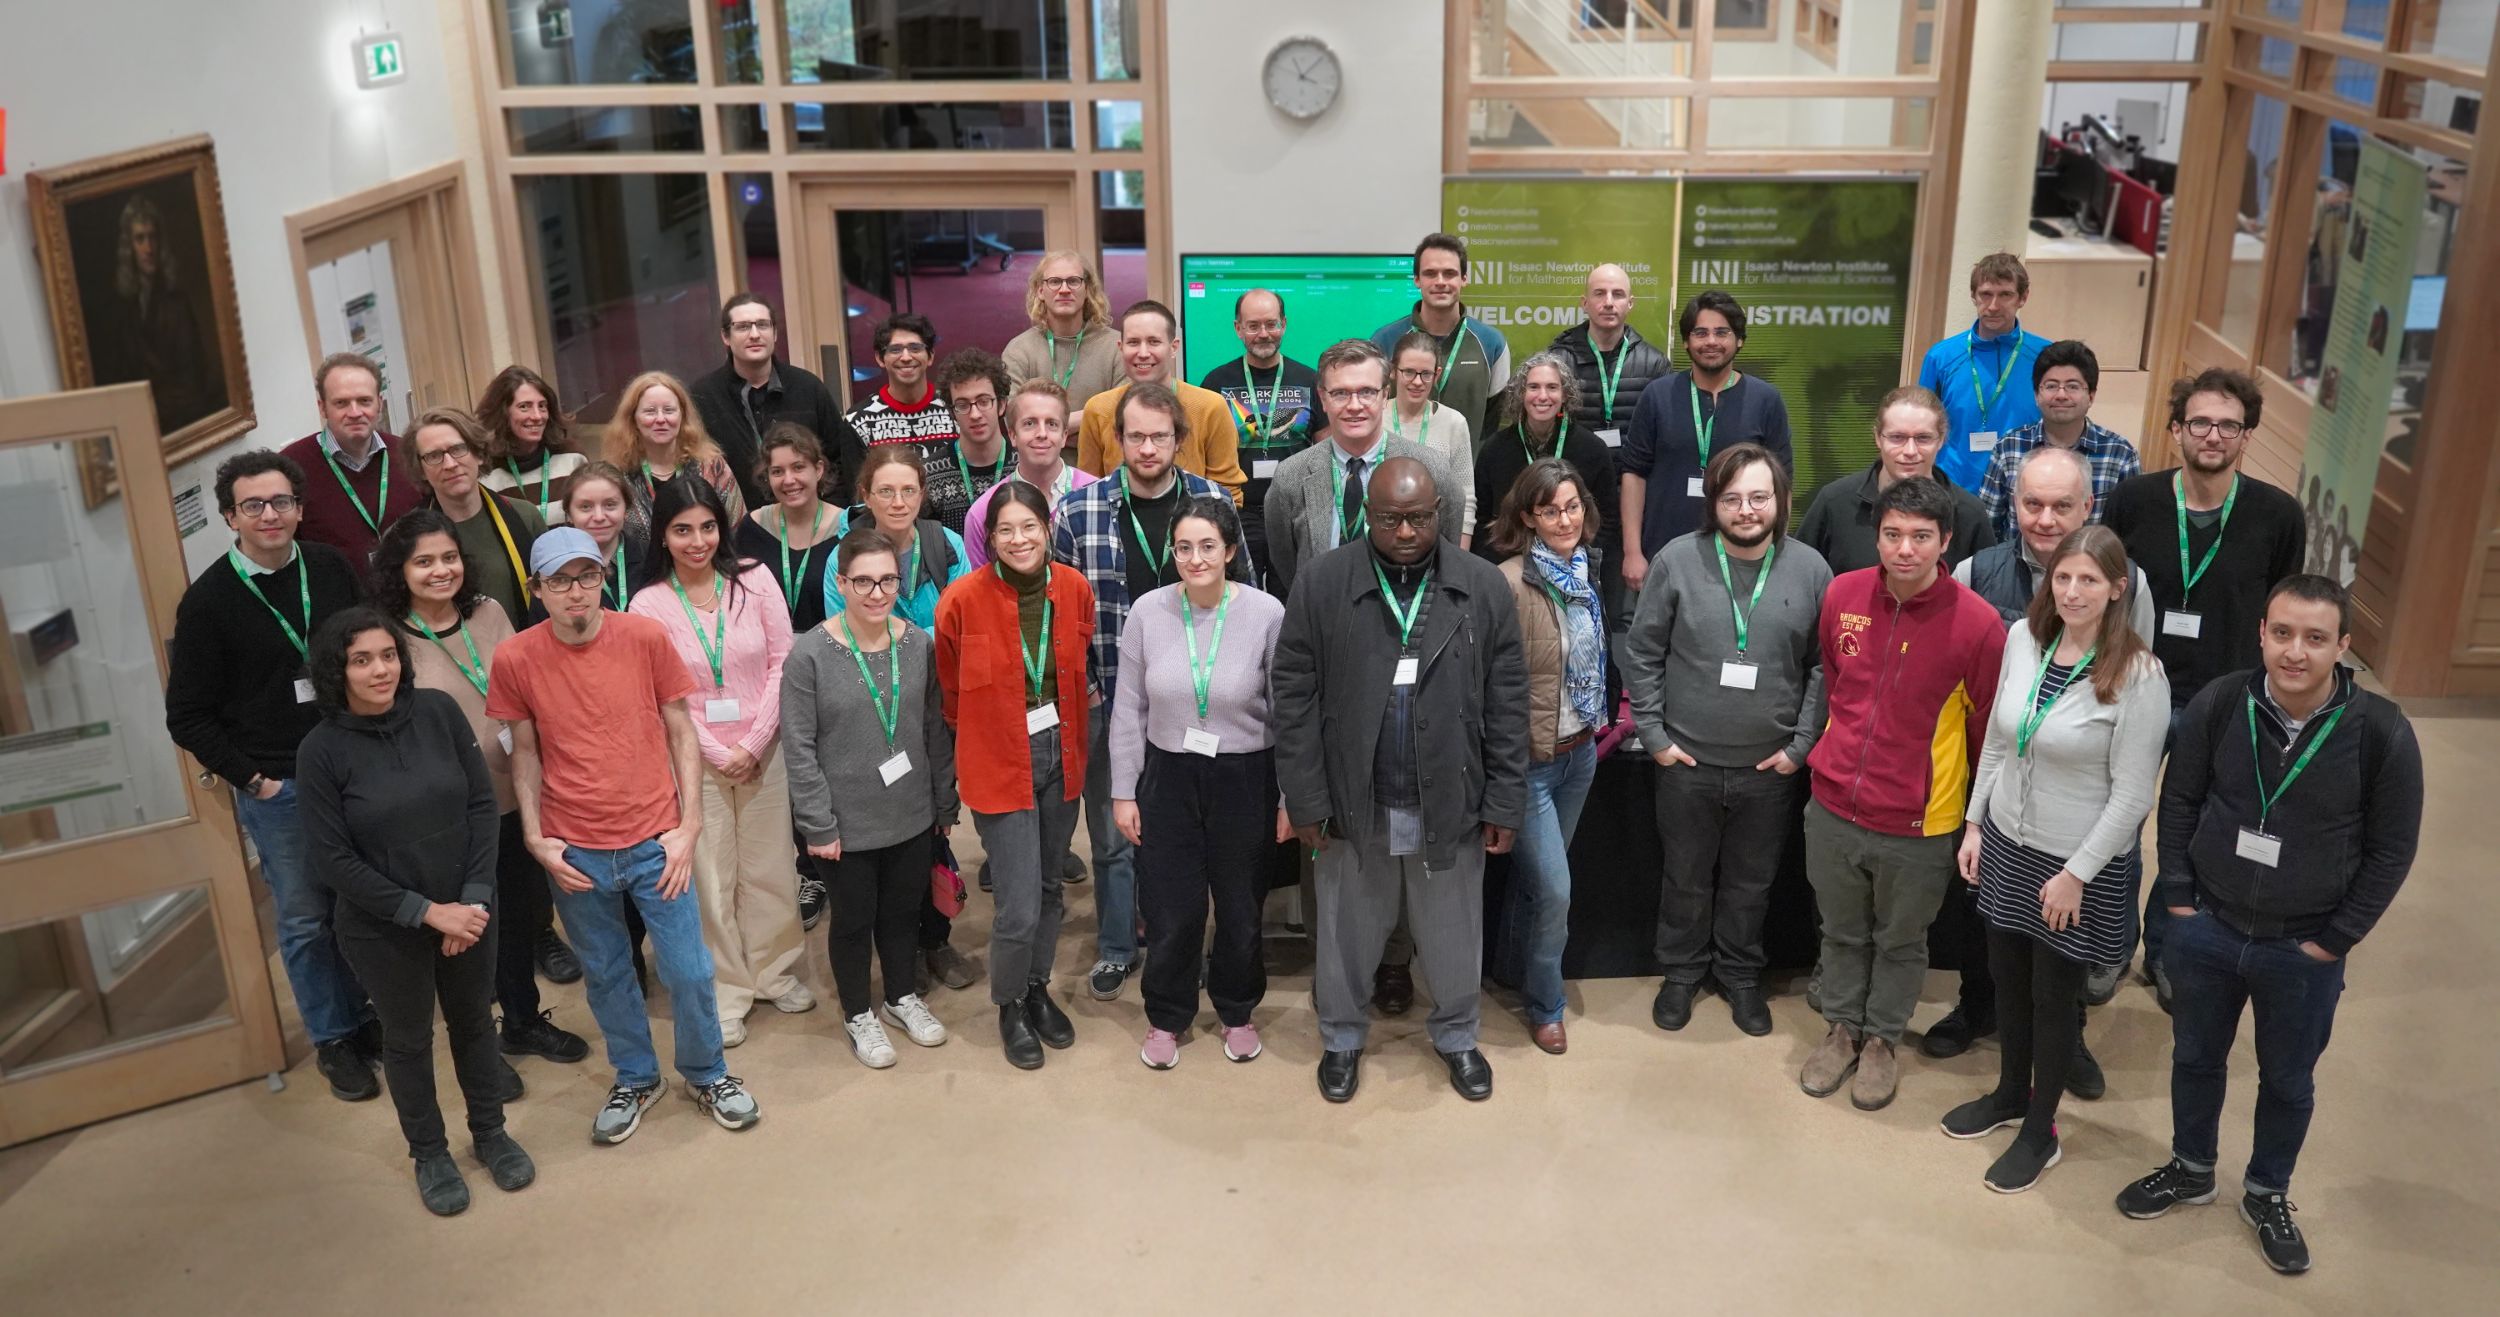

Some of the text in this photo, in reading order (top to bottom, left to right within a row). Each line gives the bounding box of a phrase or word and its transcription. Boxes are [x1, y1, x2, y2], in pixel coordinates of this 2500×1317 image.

[1508, 262, 1542, 272] Isaac
[1547, 262, 1594, 272] Newton
[1745, 261, 1889, 272] Isaac Newton Institute
[1508, 274, 1658, 285] for Mathemati nces
[1744, 273, 1896, 285] for Mathematical Sciences
[1746, 306, 1891, 326] ISTRATION
[1277, 390, 1301, 398] SIDE
[872, 419, 911, 432] STAR
[912, 415, 954, 428] STAR
[872, 428, 912, 441] WARS
[914, 424, 955, 437] WARS
[1840, 612, 1872, 626] BRONCOS
